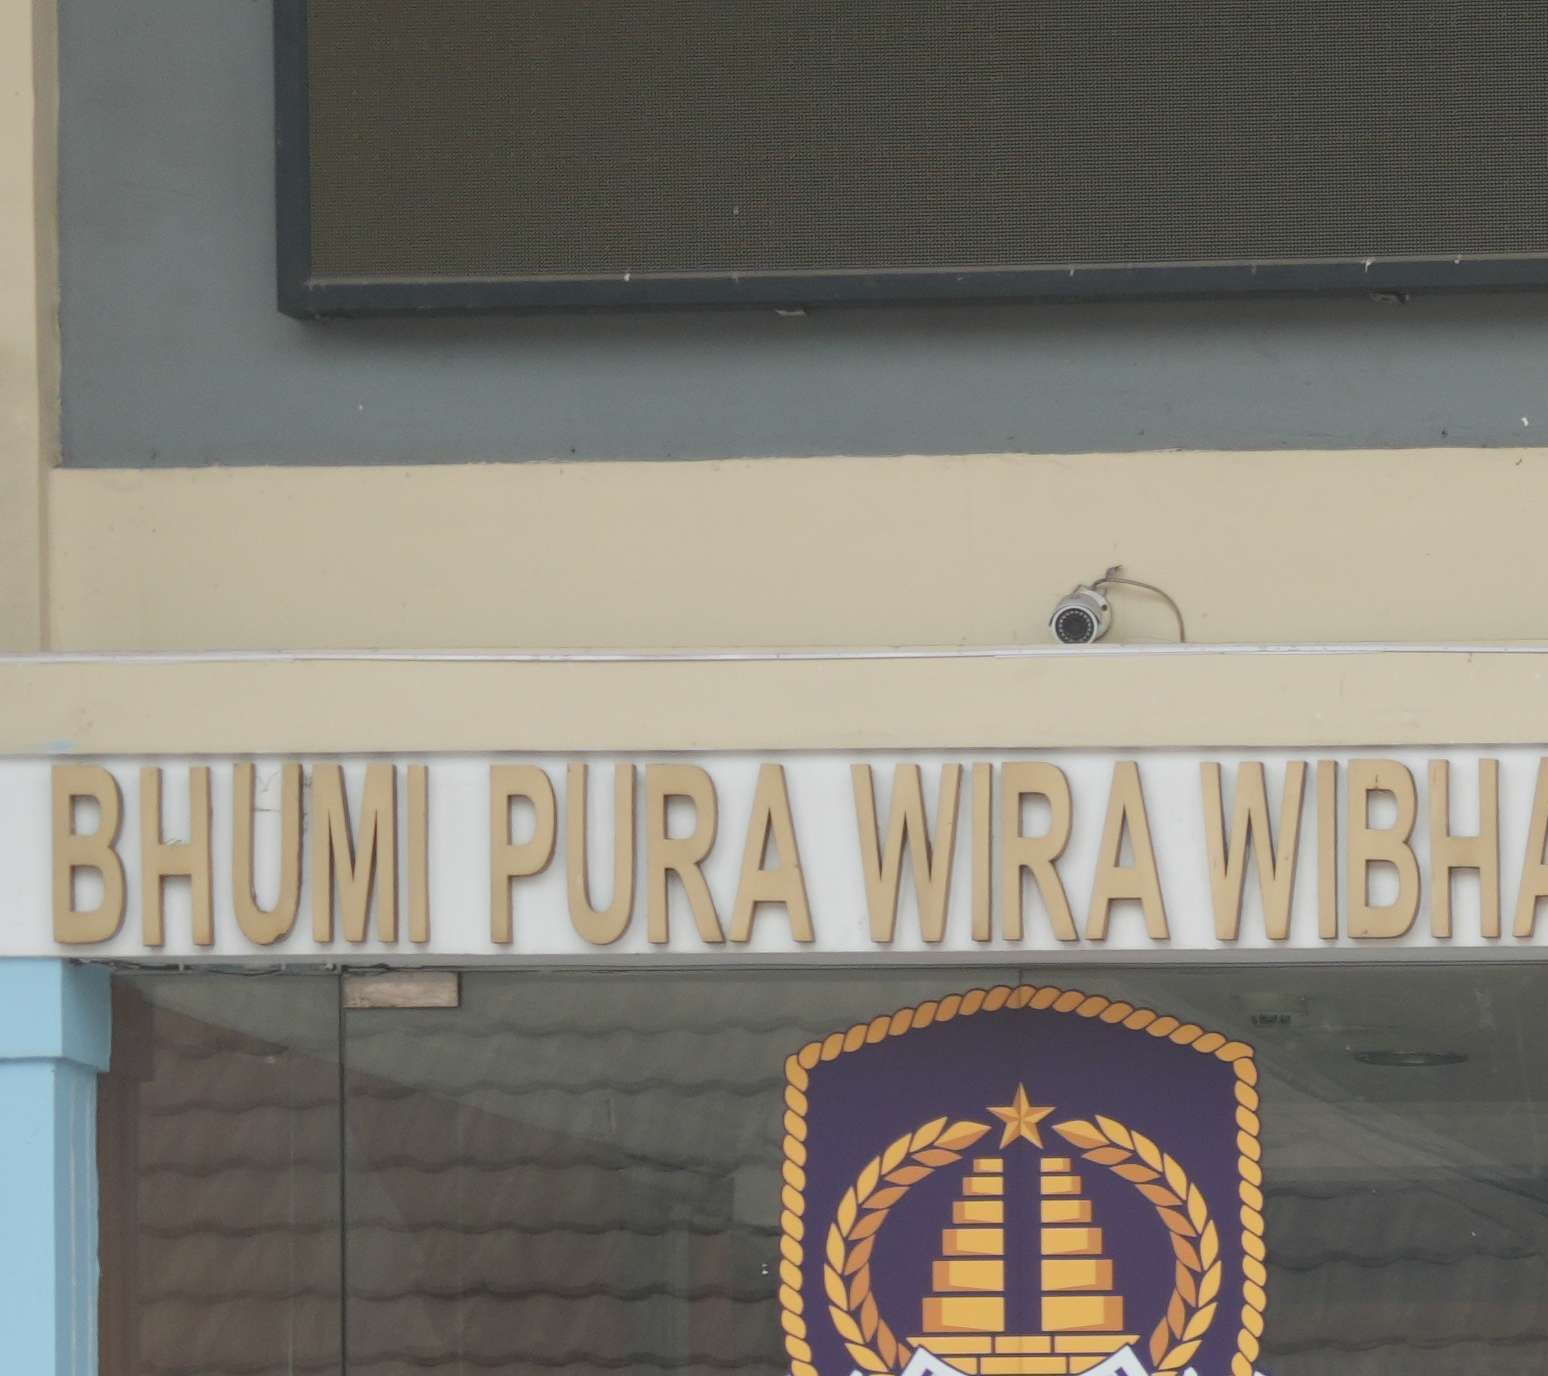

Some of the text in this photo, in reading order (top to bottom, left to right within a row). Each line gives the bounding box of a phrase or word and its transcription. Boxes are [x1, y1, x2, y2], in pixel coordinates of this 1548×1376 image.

[50, 761, 431, 948] BHUMI
[489, 762, 816, 946] PURA
[849, 760, 1172, 944] WIRA
